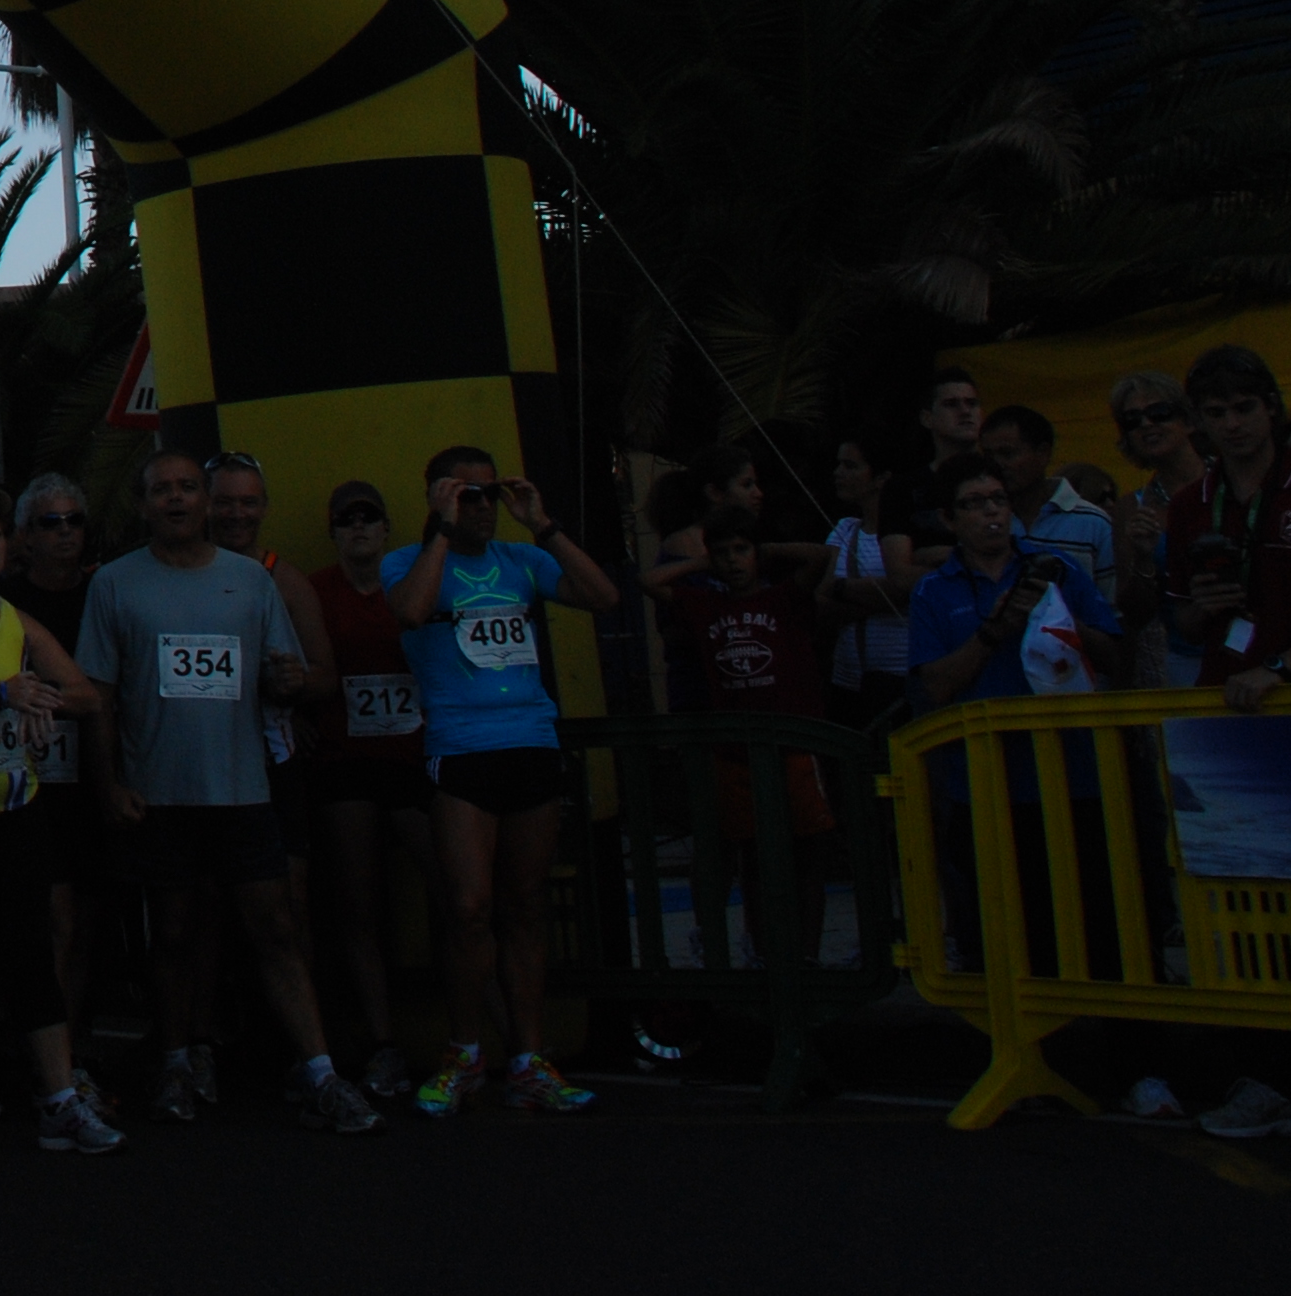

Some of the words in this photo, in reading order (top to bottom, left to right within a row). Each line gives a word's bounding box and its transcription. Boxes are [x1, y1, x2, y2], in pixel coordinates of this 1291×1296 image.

[470, 617, 525, 646] 408
[173, 648, 234, 678] 354
[357, 687, 413, 716] 212
